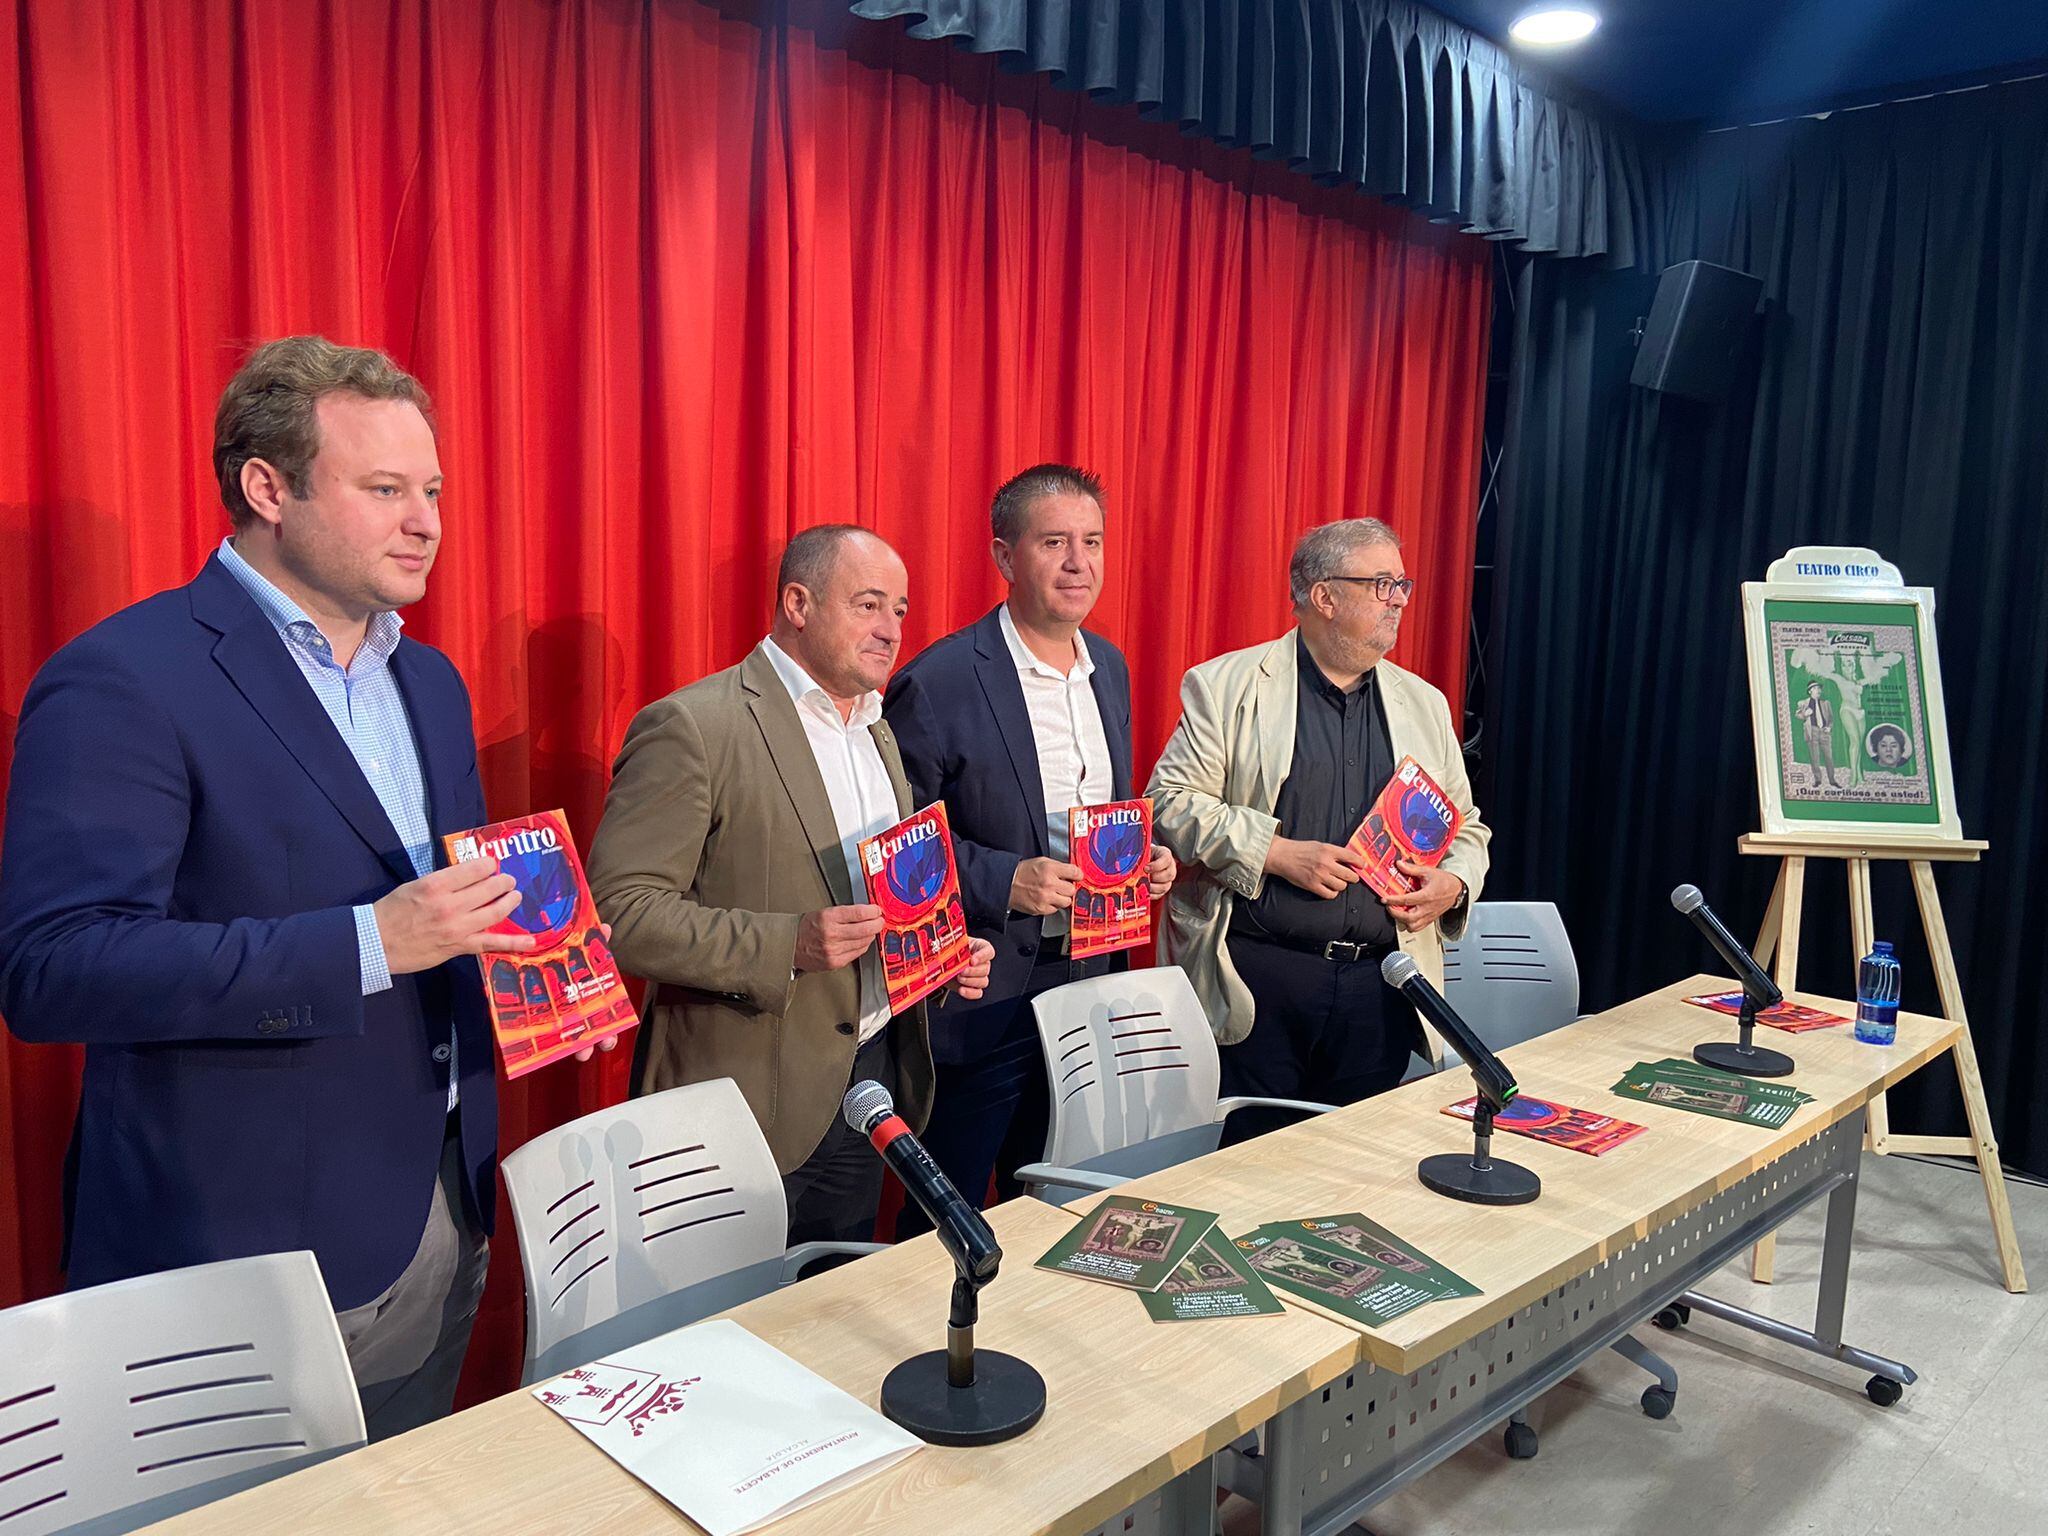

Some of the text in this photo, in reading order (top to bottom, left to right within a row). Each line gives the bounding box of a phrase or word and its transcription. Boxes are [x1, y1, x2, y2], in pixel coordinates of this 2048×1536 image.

[1796, 563, 1879, 577] TEATRO CIRCO
[765, 1439, 809, 1462] ALCALDÍA
[734, 1431, 859, 1494] AYUNTAMIENTO DE ALBACETE
